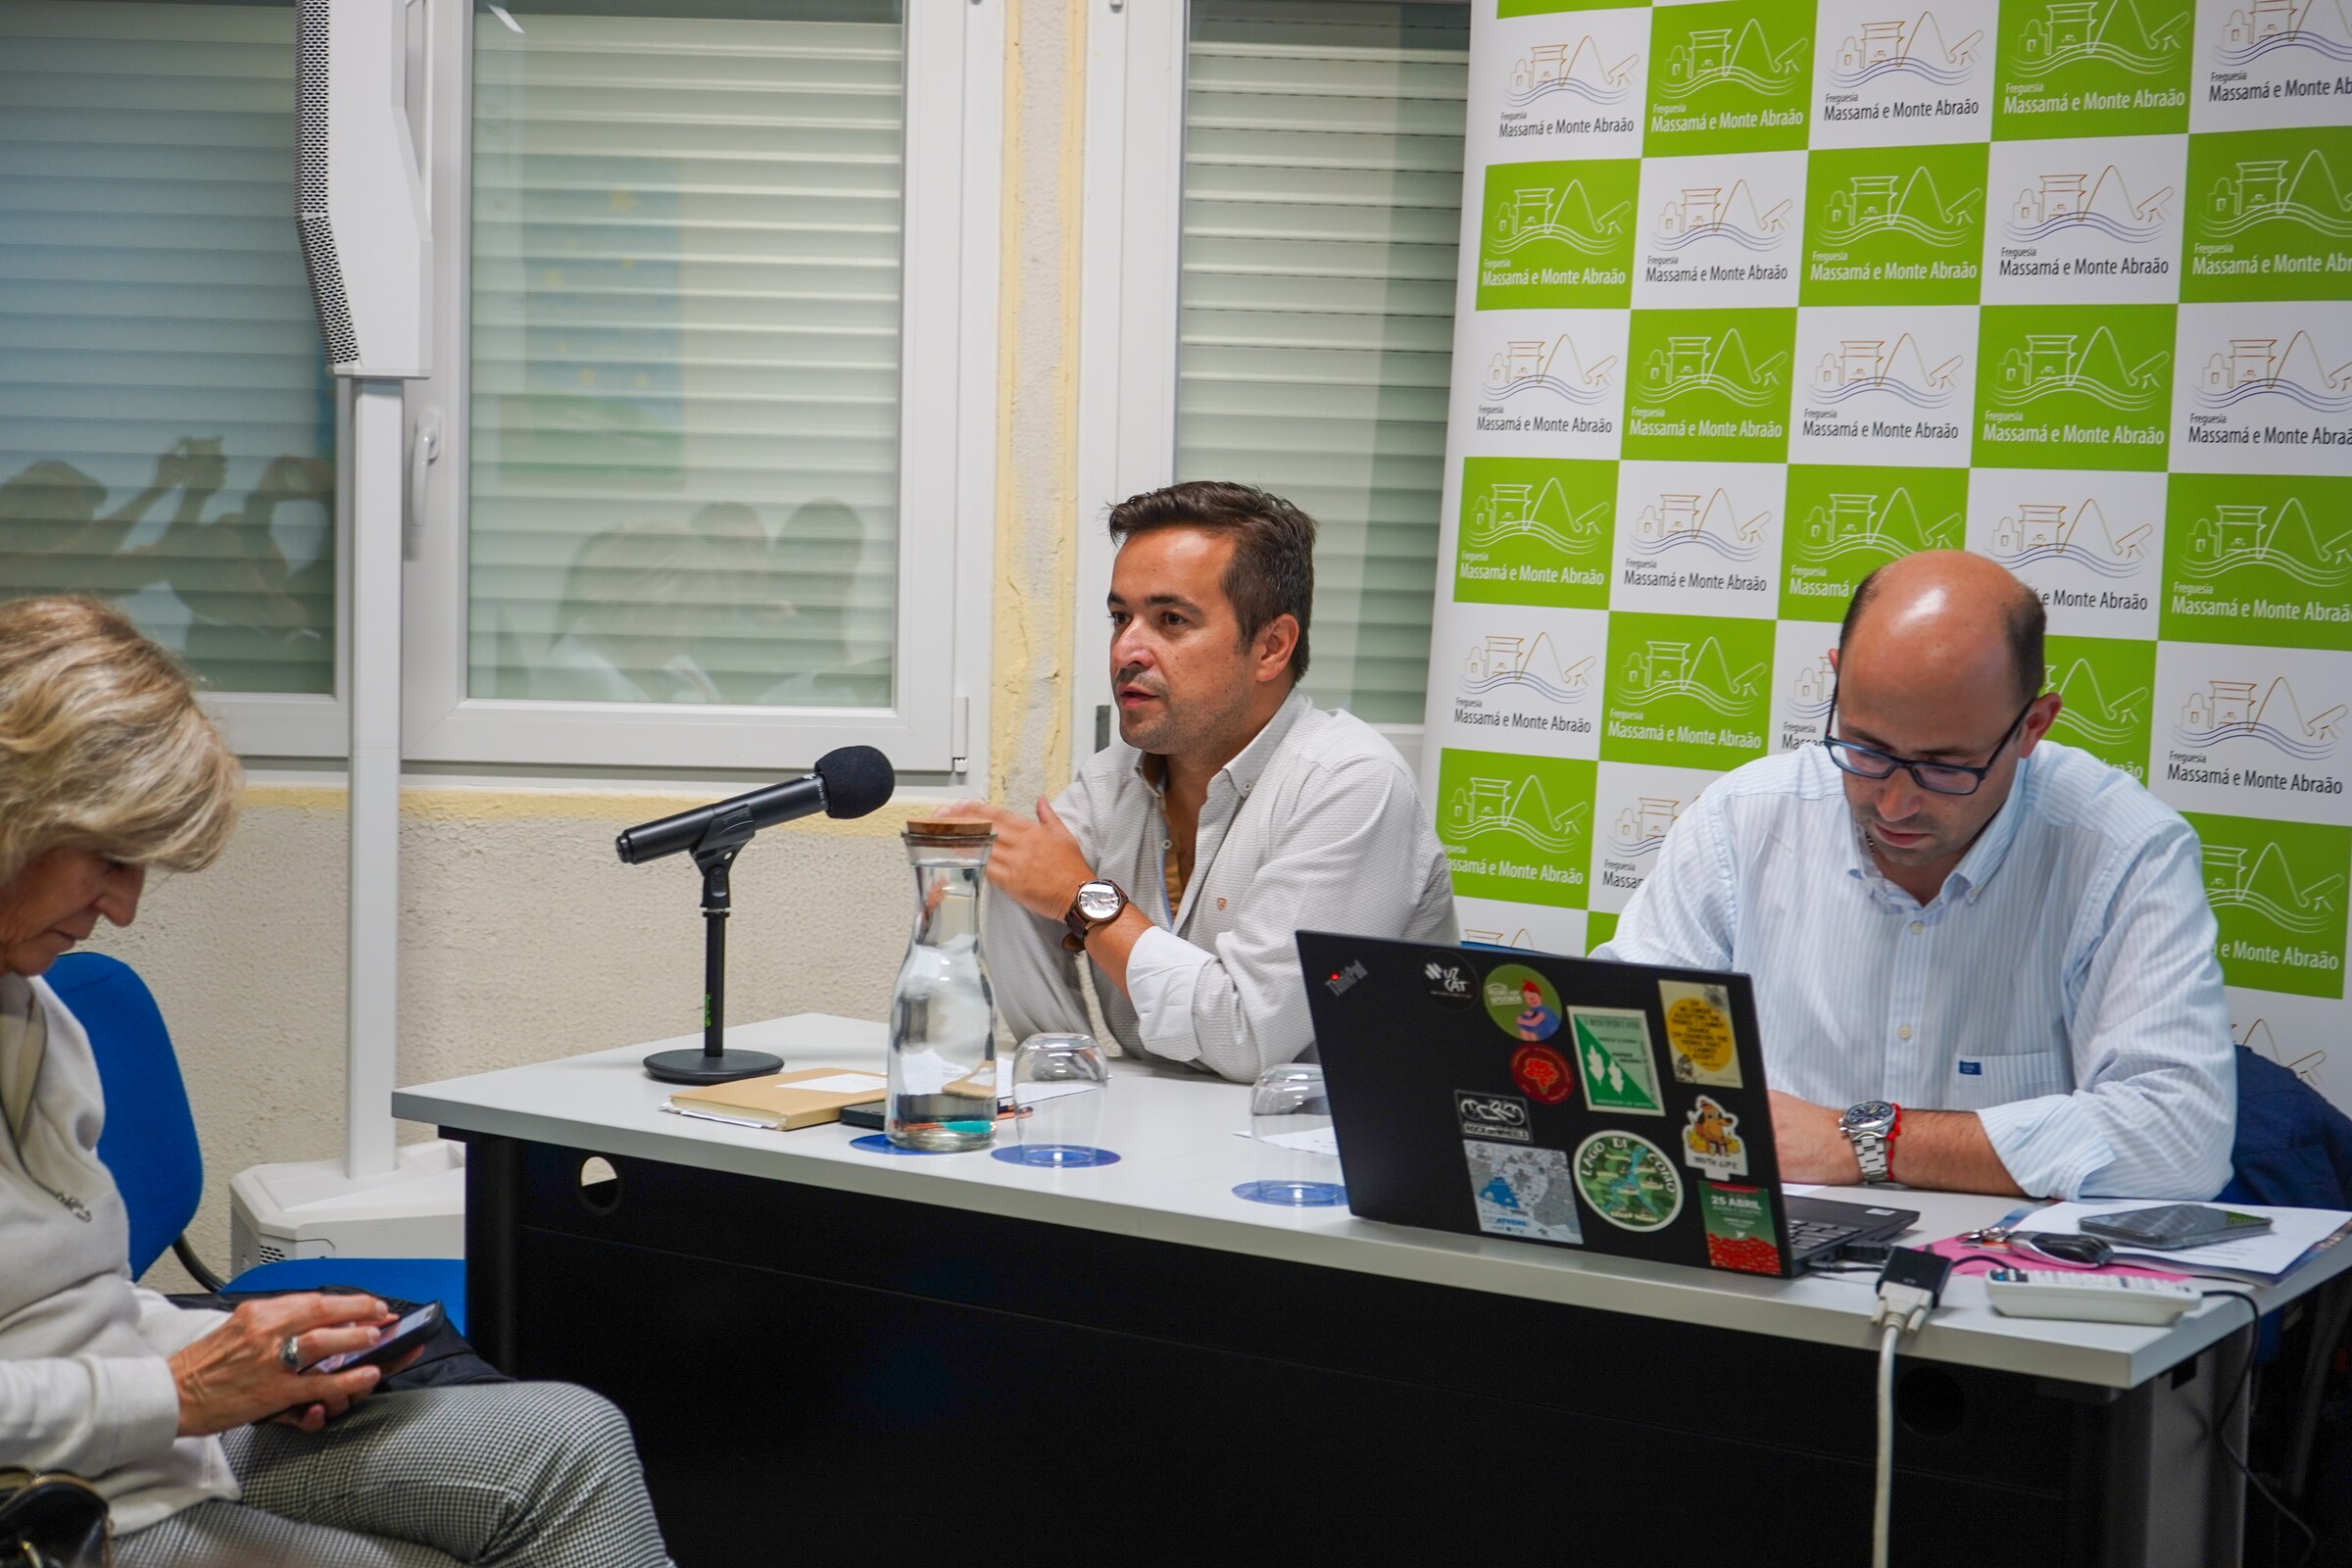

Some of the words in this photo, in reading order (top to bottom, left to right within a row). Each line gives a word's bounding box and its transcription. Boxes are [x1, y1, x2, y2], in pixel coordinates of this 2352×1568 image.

[2211, 71, 2247, 84] Freguesia
[2007, 82, 2044, 96] Freguesia
[2209, 81, 2270, 101] Massamá
[2274, 85, 2281, 97] e
[2285, 79, 2330, 96] Monte
[1826, 94, 1858, 105] Freguesia
[2004, 94, 2069, 113] Massamá
[2071, 97, 2081, 111] e
[2083, 92, 2131, 110] Monte
[2133, 89, 2185, 108] Abraão
[1501, 112, 1527, 122] Freguesia
[1653, 104, 1687, 116] Freguesia
[1825, 103, 1879, 121] Massamá
[1883, 107, 1889, 118] e
[1893, 102, 1932, 117] Monte
[1936, 100, 1979, 115] Abraão
[1499, 121, 1544, 137] Massamá
[1546, 123, 1553, 134] e
[1555, 120, 1591, 133] Monte
[1593, 118, 1634, 132] Abraão
[1651, 115, 1707, 131] Massamá
[1709, 118, 1717, 129] e
[1719, 112, 1758, 128] Monte
[1760, 110, 1803, 125] Abraão
[1813, 251, 1848, 263] Freguesia
[2001, 247, 2036, 259] Freguesia
[2194, 243, 2234, 257] Freguesia
[1484, 259, 1511, 269] Freguesia
[1647, 256, 1679, 267] Freguesia
[2000, 259, 2059, 275] Massamá
[2064, 263, 2071, 274] e
[2075, 259, 2117, 274] Monte
[2121, 258, 2169, 273] Abraão
[2193, 255, 2258, 274] Massamá
[2261, 260, 2271, 272] e
[2274, 254, 2323, 272] Monte
[2326, 253, 2352, 271] Abr
[1482, 270, 1529, 286] Massamá
[1531, 272, 1539, 284] e
[1542, 269, 1580, 284] Monte
[1582, 269, 1626, 284] Abraão
[1646, 267, 1697, 281] Massamá
[1700, 270, 1707, 281] e
[1710, 267, 1745, 280] Monte
[1748, 265, 1788, 279] Abraão
[1811, 264, 1870, 280] Massamá
[1874, 267, 1882, 279] e
[1885, 263, 1928, 279] Monte
[1931, 262, 1978, 278] Abraão
[1479, 405, 1503, 416] Freguesia
[1632, 408, 1665, 418] Freguesia
[1804, 409, 1838, 420] Freguesia
[1985, 412, 2023, 423] Freguesia
[1477, 416, 1521, 430] Massamá
[1524, 420, 1530, 431] e
[1534, 416, 1569, 431] Monte
[1572, 417, 1612, 432] Abraão
[2190, 414, 2227, 425] Freguesia
[1630, 419, 1686, 436] Massamá
[1688, 424, 1696, 436] e
[1698, 420, 1738, 437] Monte
[1740, 420, 1783, 437] Abraão
[1803, 420, 1858, 436] Massamá
[1862, 425, 1869, 437] e
[1872, 421, 1912, 438] Monte
[1915, 422, 1958, 438] Abraão
[1984, 423, 2048, 442] Massamá
[2050, 429, 2060, 442] e
[2063, 425, 2110, 443] Monte
[2113, 425, 2165, 444] Abraão
[2188, 426, 2249, 443] Massamá
[2253, 431, 2260, 443] e
[2264, 427, 2308, 444] Monte
[2312, 427, 2352, 445] Abraã
[1460, 551, 1489, 563] Freguesia
[1626, 558, 1657, 570] Freguesia
[1460, 563, 1507, 580] Massamá
[1509, 568, 1517, 580] e
[1519, 564, 1558, 582] Monte
[1560, 567, 1604, 584] Abraão
[1791, 564, 1827, 578] Freguesia
[1624, 570, 1676, 587] Massamá
[1679, 576, 1686, 587] e
[1689, 573, 1724, 589] Monte
[1727, 574, 1766, 591] Abraão
[1789, 578, 1850, 596] Massamá
[2174, 582, 2215, 596] Freguesia
[2053, 590, 2096, 608] Monte
[2100, 592, 2147, 610] Abraão
[2172, 596, 2239, 615] Massamá
[2241, 604, 2251, 617] e
[2253, 600, 2301, 619] Monte
[2304, 602, 2352, 622] Abraã
[1456, 697, 1482, 709] Freguesia
[1454, 709, 1499, 725] Massamá
[1503, 716, 1509, 726] e
[1512, 713, 1547, 729] Monte
[1550, 716, 1591, 733] Abraão
[1611, 709, 1643, 721] Freguesia
[1608, 720, 1664, 741] Massamá
[1666, 729, 1675, 741] e
[1678, 725, 1716, 745] Monte
[1718, 729, 1762, 749] Abraão
[1784, 721, 1816, 734] Freguesia
[2170, 751, 2206, 764] Freguesia
[2168, 763, 2230, 784] Massamá
[2233, 773, 2240, 786] e
[2244, 770, 2287, 790] Monte
[2290, 774, 2342, 794] Abraão
[1447, 858, 1487, 874] assamá
[1489, 863, 1496, 874] e
[1498, 861, 1538, 879] Monte
[1541, 864, 1584, 884] Abraão
[1605, 859, 1636, 871] Freguesia
[2222, 945, 2230, 956] e
[2233, 941, 2280, 963] Monte
[2282, 947, 2339, 970] Abraão
[1582, 1142, 1605, 1176] LAGO
[1612, 1138, 1628, 1149] DI
[1646, 1152, 1676, 1193] COMO
[1710, 1196, 1727, 1205] 25
[1729, 1198, 1763, 1210] ABRIL
